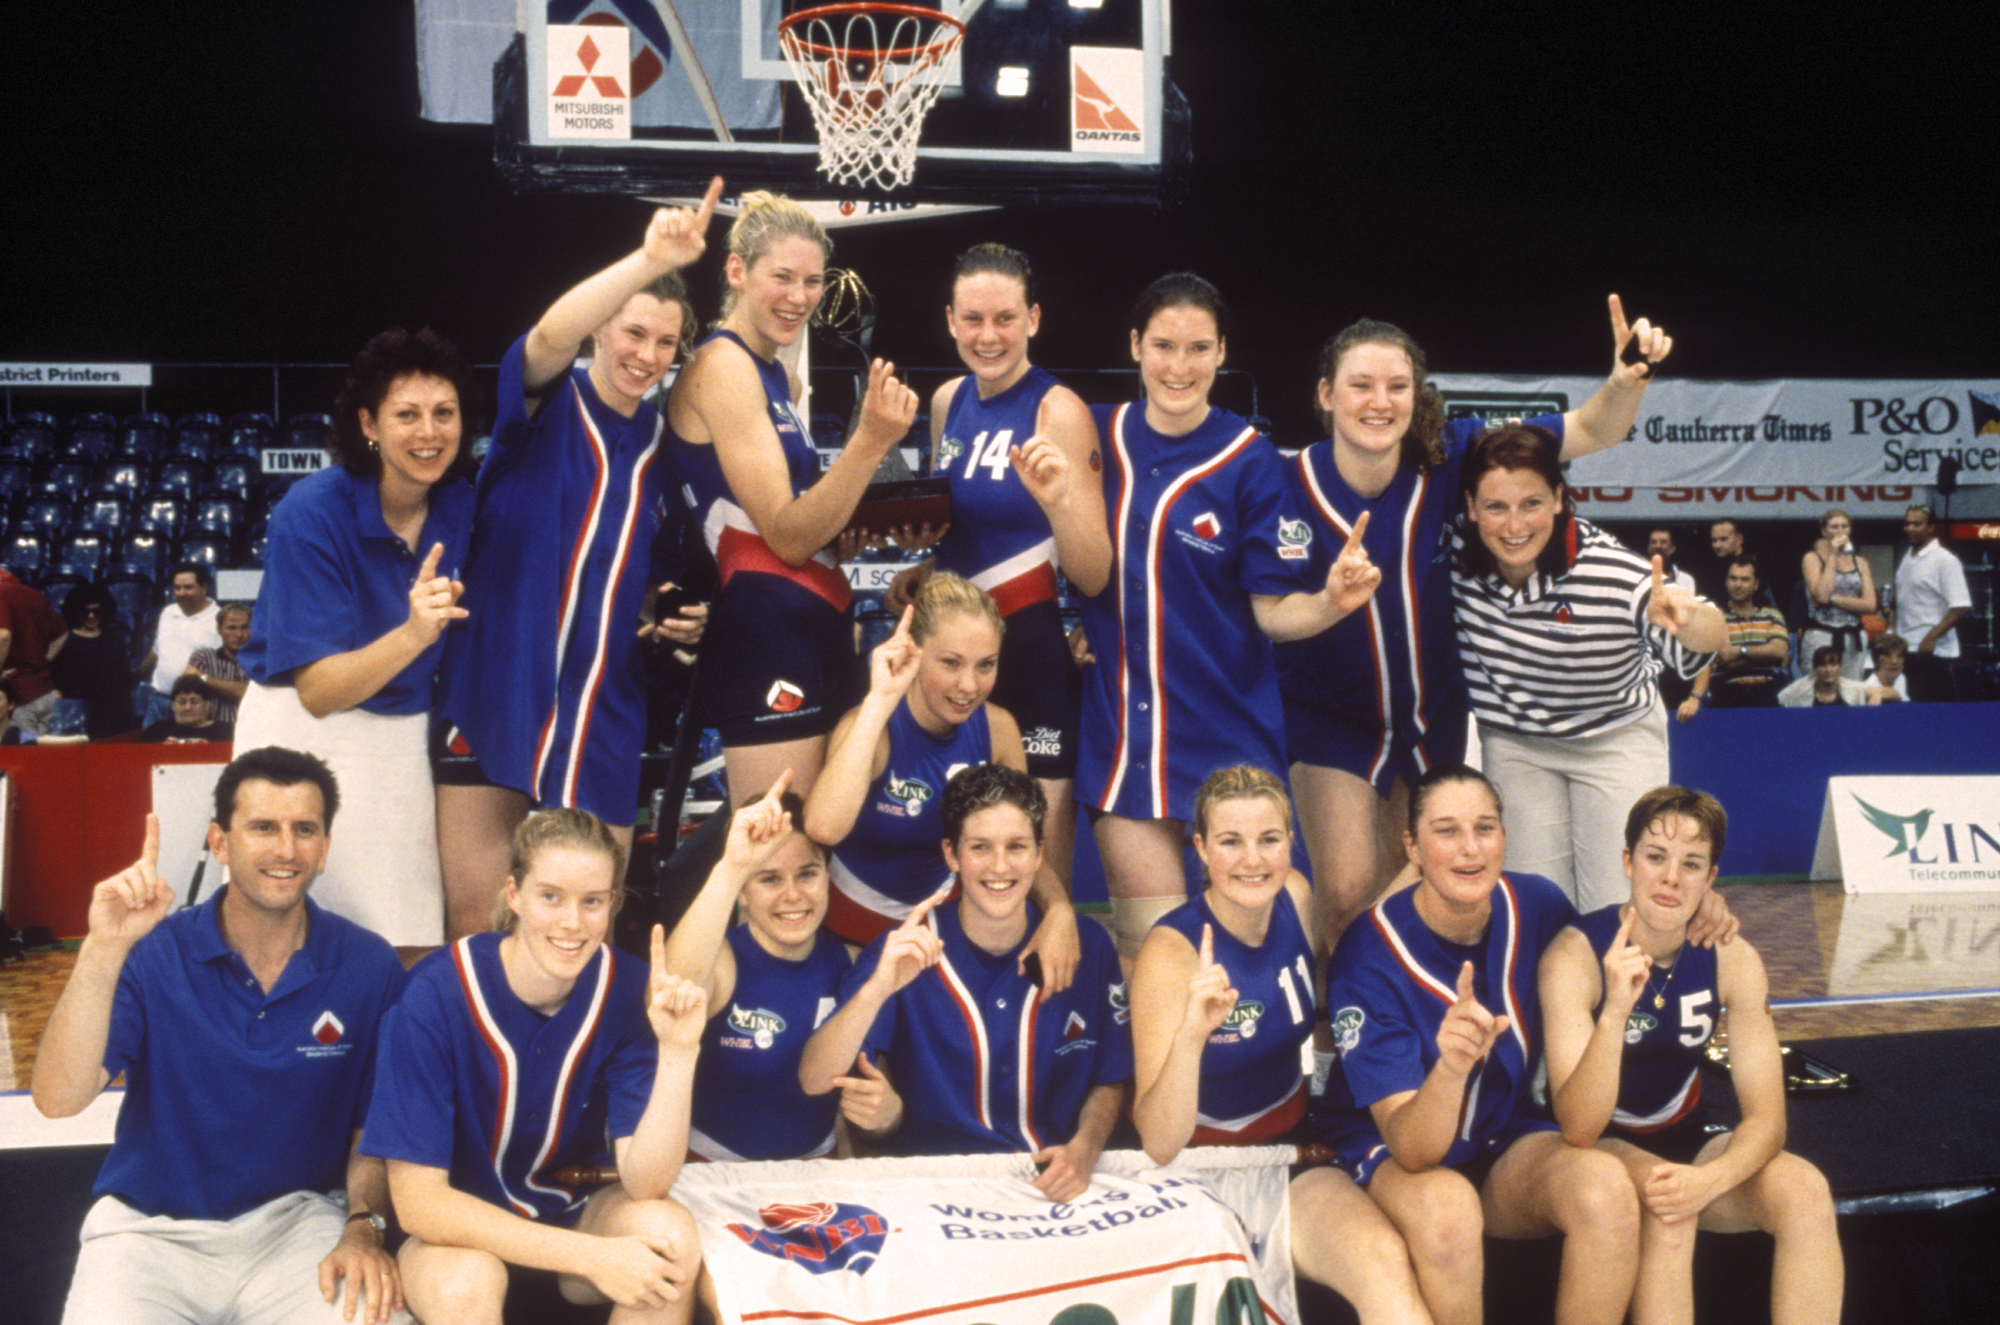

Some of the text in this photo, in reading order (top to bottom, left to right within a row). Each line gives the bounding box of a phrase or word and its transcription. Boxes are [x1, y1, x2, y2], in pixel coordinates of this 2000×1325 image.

[555, 102, 624, 115] MITSUBISHI
[564, 117, 614, 130] MOTORS
[1075, 130, 1141, 142] QANTAS
[48, 368, 121, 381] Printers
[1848, 396, 1960, 435] P&O
[1645, 414, 1756, 443] Canberra
[1762, 414, 1833, 443] Times
[267, 452, 322, 469] TOWN
[963, 430, 1014, 481] 14
[1883, 439, 2000, 473] Service
[1034, 726, 1061, 739] Diet
[1021, 736, 1061, 755] Coke
[1909, 869, 2000, 881] Telecommu
[1278, 954, 1317, 1025] 11
[1679, 990, 1712, 1047] 5
